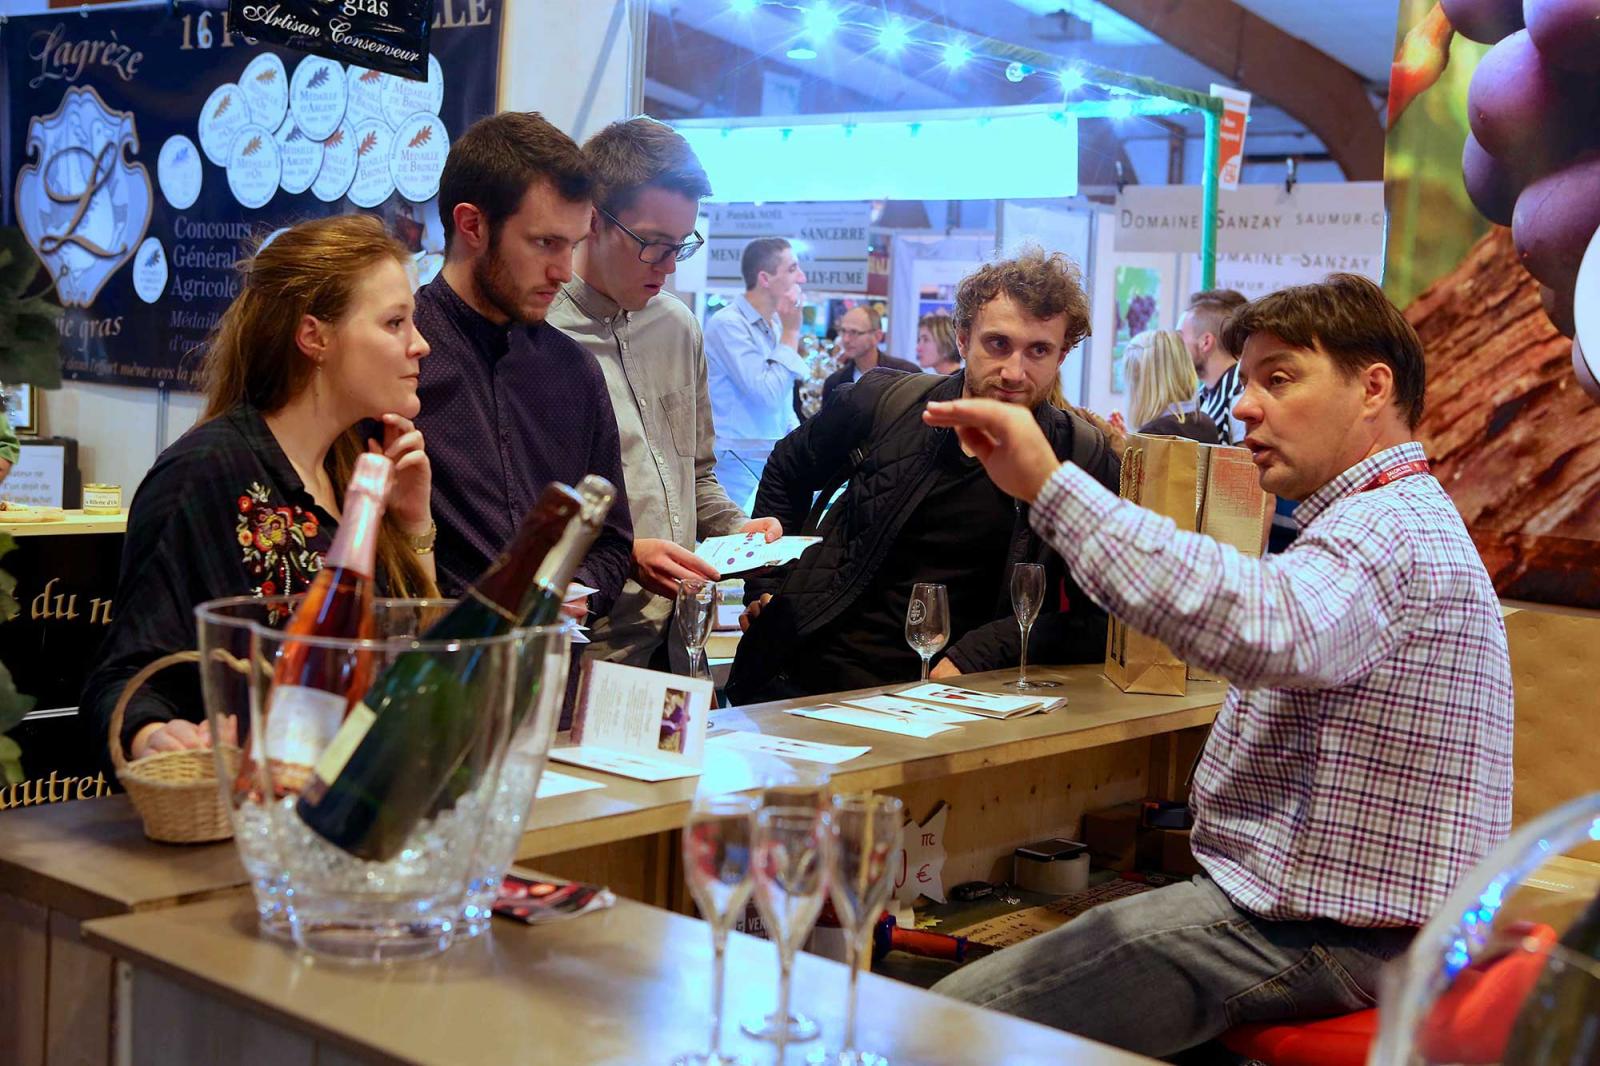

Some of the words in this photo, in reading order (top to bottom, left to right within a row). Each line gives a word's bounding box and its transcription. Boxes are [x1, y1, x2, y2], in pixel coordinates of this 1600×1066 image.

[180, 10, 213, 50] 16
[243, 4, 321, 37] Artisan
[329, 18, 420, 62] Conserveur
[29, 23, 144, 89] Lagrèze
[173, 215, 252, 240] Concours
[1121, 208, 1199, 229] DOMAINE
[800, 226, 865, 241] SANCERRE
[172, 243, 238, 270] Général
[170, 275, 239, 302] Agricole
[806, 268, 864, 285] LLY-FUMÉ
[78, 315, 124, 352] gras
[168, 310, 223, 331] Médaill
[31, 577, 80, 620] du
